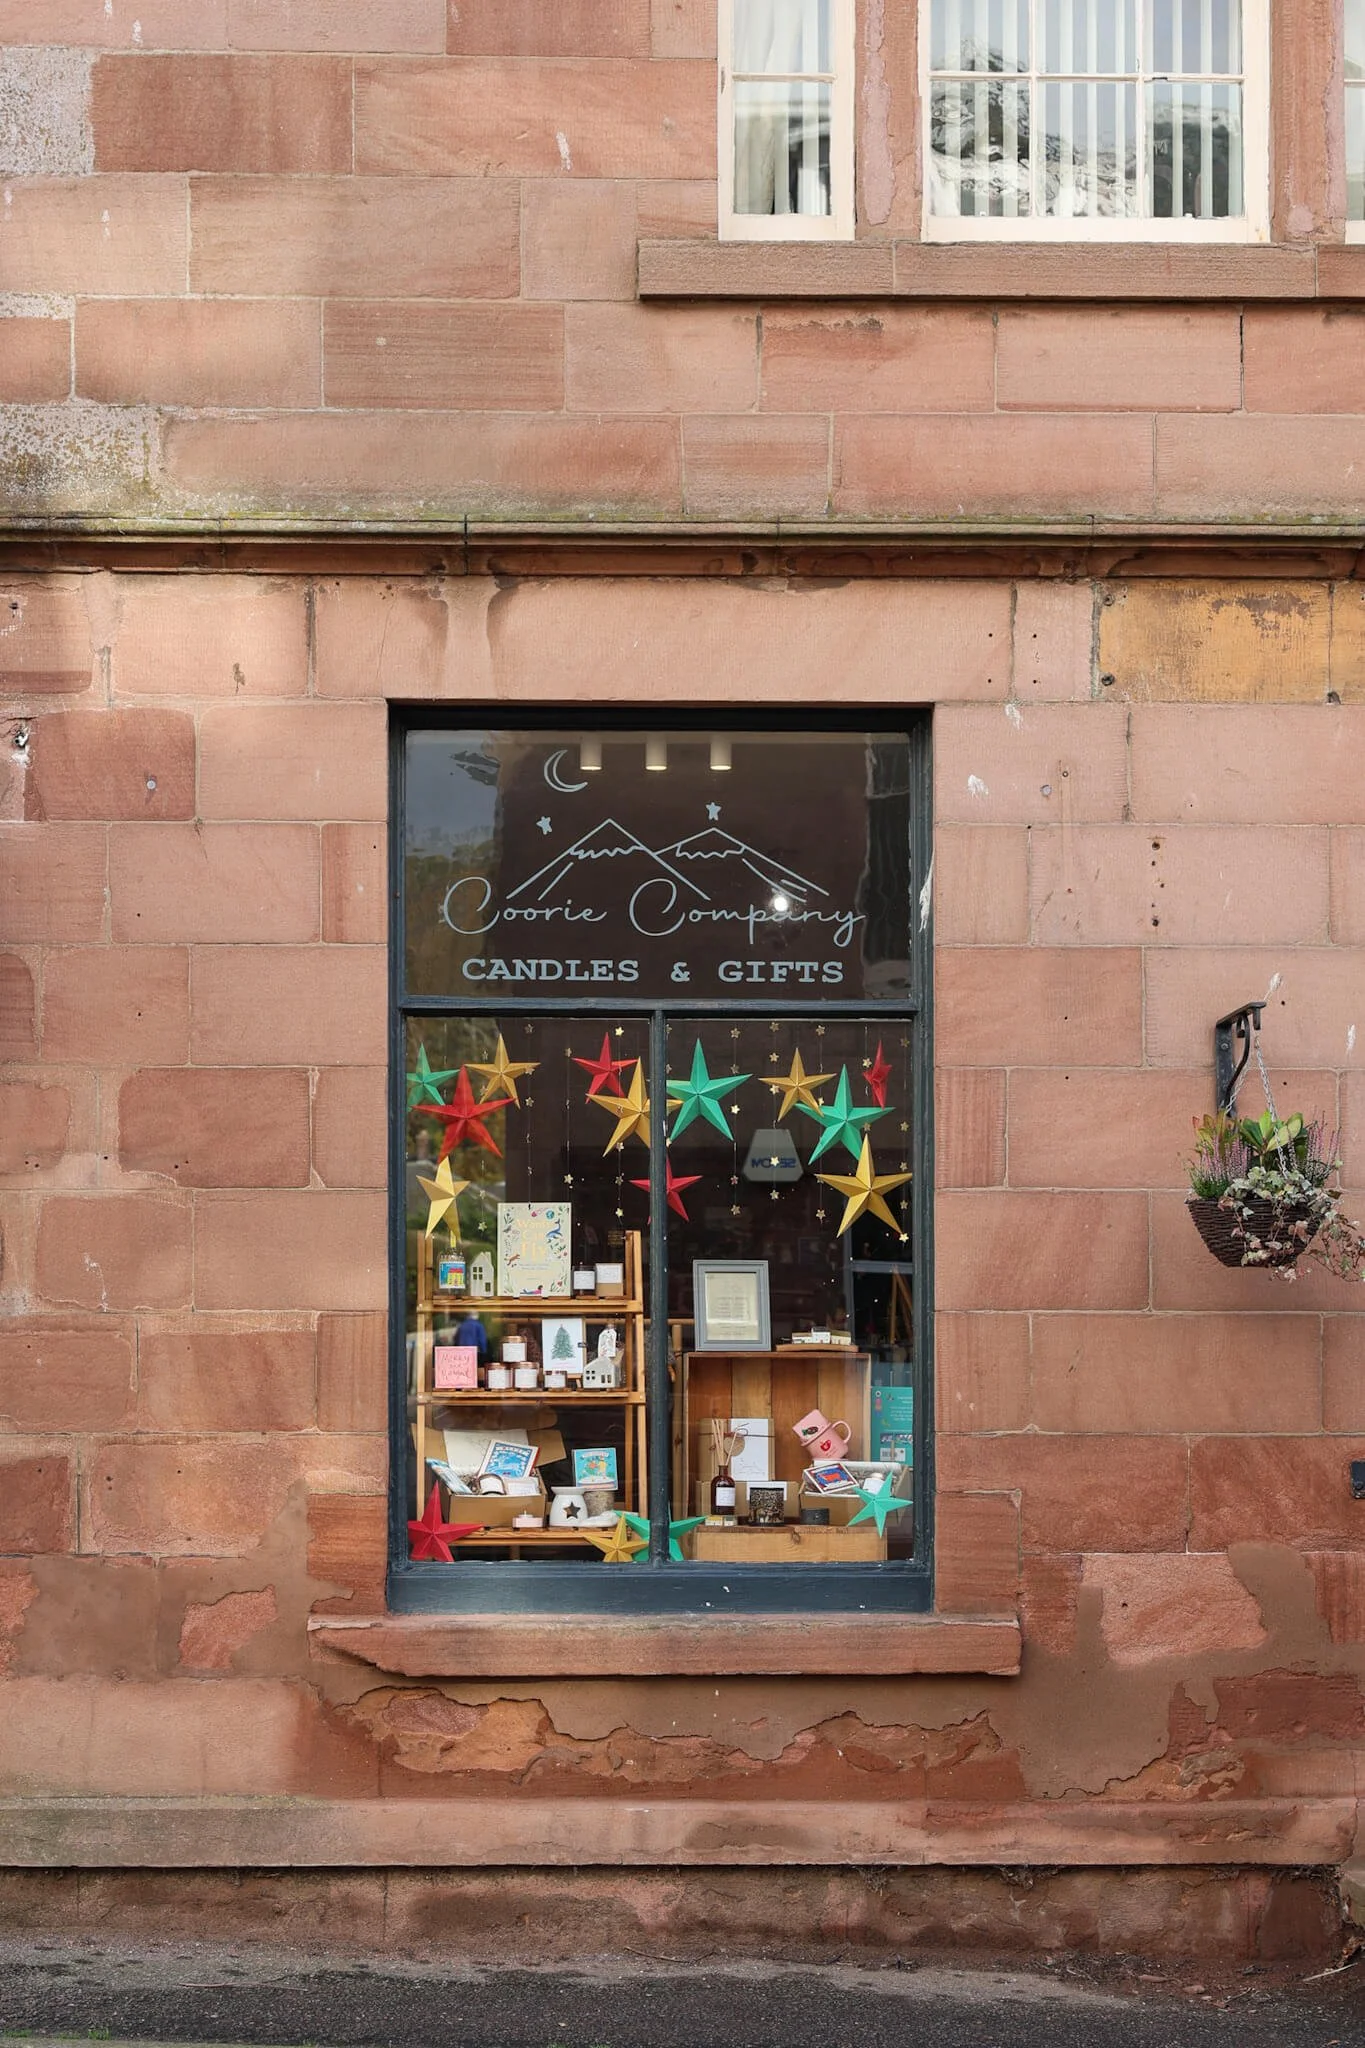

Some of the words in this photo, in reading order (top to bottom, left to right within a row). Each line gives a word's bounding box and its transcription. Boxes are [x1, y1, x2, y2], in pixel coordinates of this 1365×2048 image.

[443, 876, 608, 935] Coorie
[629, 877, 867, 948] Company
[462, 958, 639, 982] CANDLES
[670, 961, 690, 983] &
[718, 960, 844, 983] GIFTS
